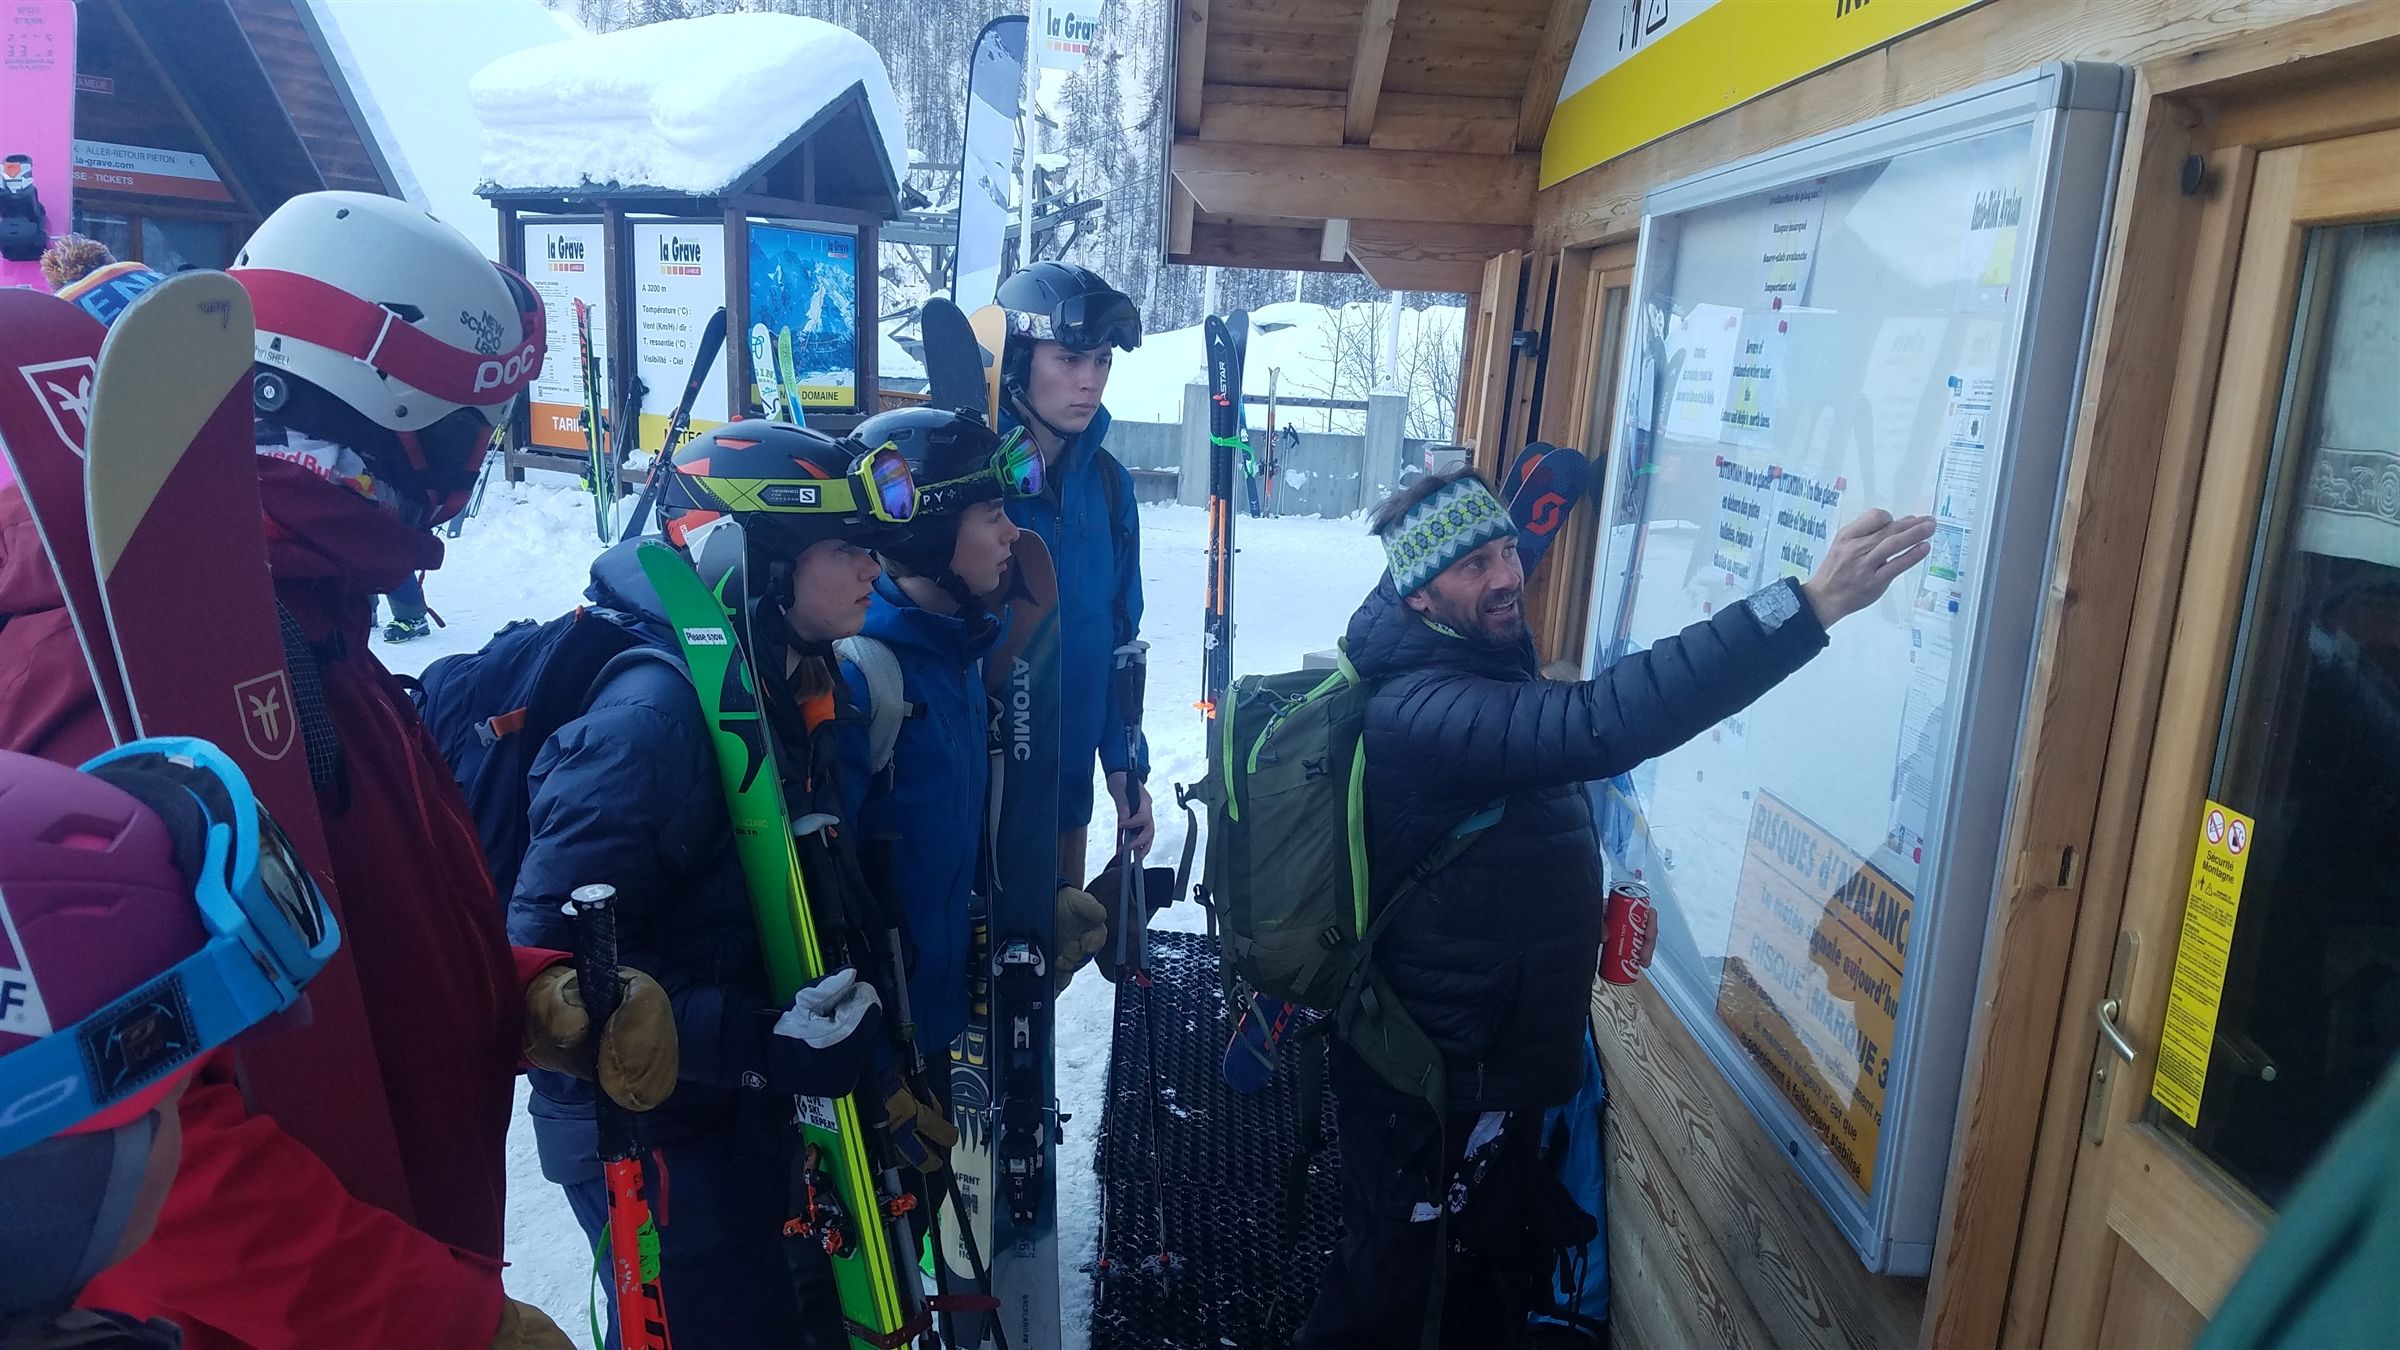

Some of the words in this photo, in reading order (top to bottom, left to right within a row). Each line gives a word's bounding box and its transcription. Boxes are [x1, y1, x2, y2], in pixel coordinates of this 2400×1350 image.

[1064, 12, 1099, 42] Gra
[95, 173, 134, 185] TICKETS
[547, 234, 556, 259] la
[558, 235, 584, 260] Grave
[659, 234, 669, 262] la
[672, 236, 701, 262] Grave
[647, 284, 660, 293] 3200
[642, 305, 677, 315] Température
[459, 311, 502, 349] SCHOO
[481, 311, 504, 337] NEW
[642, 321, 655, 331] Vent
[649, 338, 674, 348] ressentie
[643, 354, 667, 364] Visibilité
[672, 356, 684, 365] Ciel
[801, 390, 839, 401] DOMAINE
[686, 631, 706, 642] Please
[1011, 655, 1031, 762] ATOMIC
[2202, 860, 2235, 884] Montagne
[2207, 850, 2234, 871] Sécurité
[1754, 804, 1818, 878] RISQUES
[1819, 848, 1911, 957] d'AVALANC
[1842, 956, 1899, 1021] aujourd'hu
[1751, 936, 1804, 998] RISQUE
[1878, 1058, 1889, 1090] 3
[1793, 1057, 1823, 1097] neigeux
[1824, 1090, 1842, 1119] n'est
[1843, 1117, 1857, 1142] que
[1792, 1084, 1830, 1137] faiblement
[1830, 1131, 1862, 1179] stabilisé
